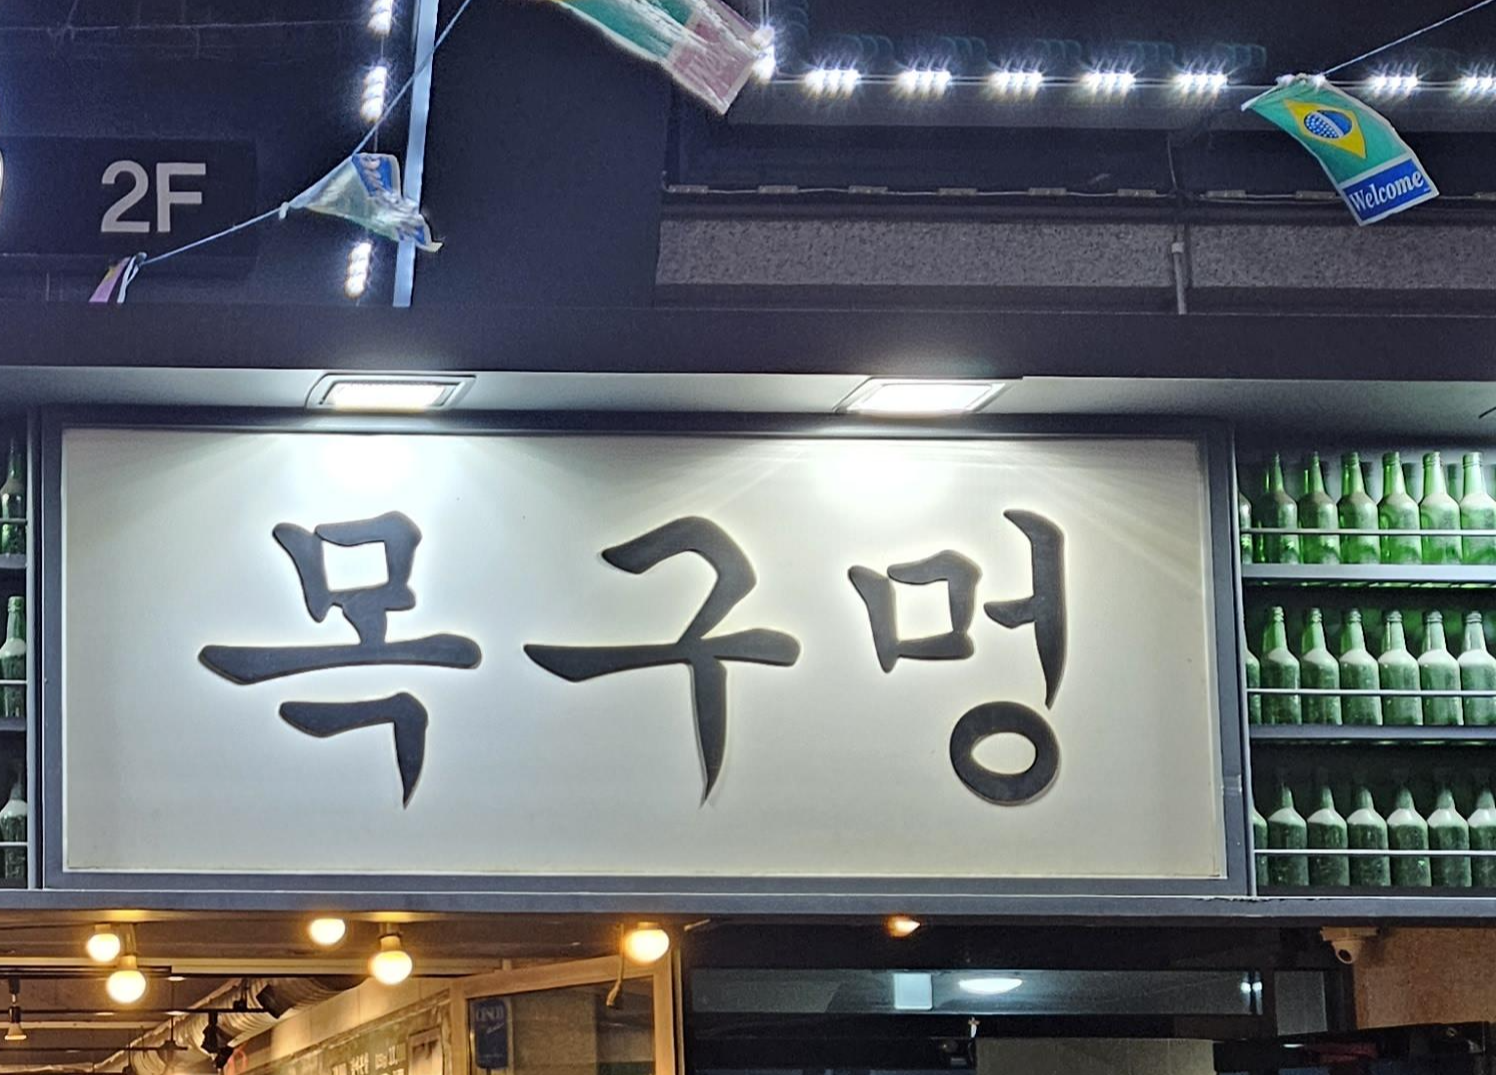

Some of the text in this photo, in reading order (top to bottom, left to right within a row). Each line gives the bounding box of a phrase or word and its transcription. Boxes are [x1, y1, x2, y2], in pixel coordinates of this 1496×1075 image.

[100, 160, 208, 236] 2F
[1350, 169, 1425, 213] Welcome
[196, 509, 1068, 811] 목구멍
